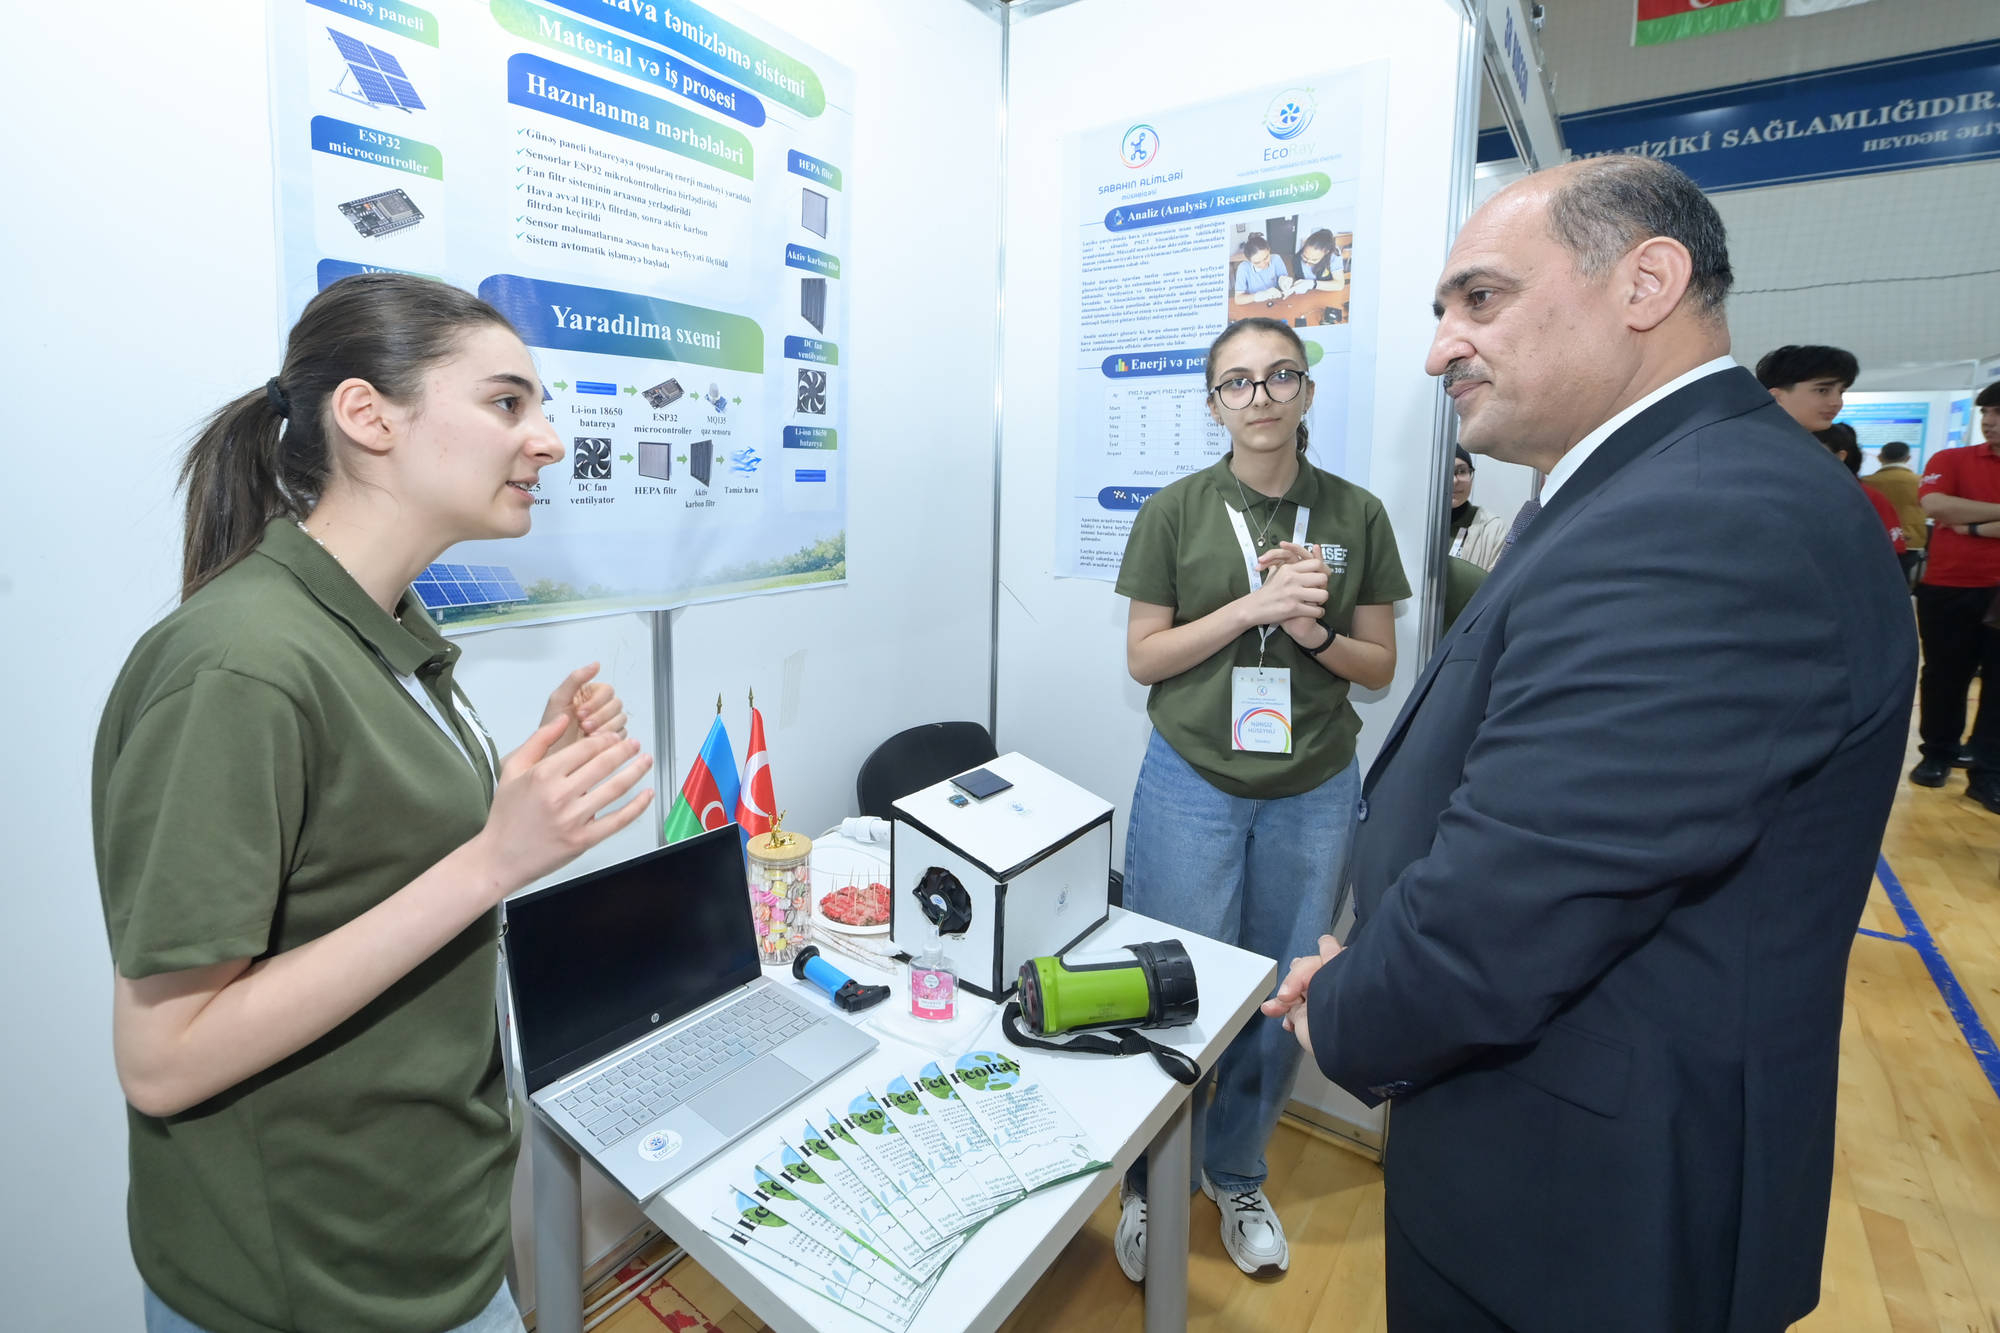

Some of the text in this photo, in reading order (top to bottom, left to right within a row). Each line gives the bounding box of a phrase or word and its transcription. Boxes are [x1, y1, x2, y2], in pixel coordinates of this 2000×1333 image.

[339, 0, 424, 32] nəş paneli
[602, 0, 805, 98] ava təmizləmə sistemi
[538, 14, 736, 111] Material və iş prosesi
[526, 72, 744, 165] Hazırlanma mərhələləri
[358, 128, 401, 150] ESP32
[526, 128, 557, 145] Günəş
[559, 139, 586, 153] paneli
[1862, 129, 1949, 153] HEYDƏR
[328, 141, 430, 174] microcontroller
[525, 147, 572, 167] Sensorlar
[574, 160, 602, 176] ESP32
[799, 158, 821, 176] HEPA
[526, 166, 545, 179] Fan
[548, 171, 567, 183] filtr
[568, 177, 611, 196] sisteminin
[1098, 169, 1184, 195] SABAHIN ALİMLƏRİ
[526, 185, 553, 198] Hava
[581, 195, 606, 211] HEPA
[641, 214, 662, 225] sonra
[663, 219, 681, 230] aktiv
[1128, 208, 1160, 222] Analiz
[1161, 200, 1208, 217] (Analysis
[1216, 189, 1266, 207] Research
[1268, 179, 1320, 197] analysis)
[525, 216, 559, 230] Sensor
[526, 233, 558, 248] Sistem
[560, 241, 606, 257] avtomatik
[551, 305, 721, 350] Yaradılma sxemi
[1131, 357, 1206, 371] Enerji və per
[571, 404, 623, 416] Li-ion 18650
[653, 412, 678, 422] ESP32
[579, 418, 616, 430] batareya
[634, 425, 692, 435] microcontroller
[578, 483, 608, 492] DC fan
[634, 486, 678, 495] HEPA filtr
[570, 496, 615, 506] ventilyator
[950, 1060, 1021, 1084] EcoRay
